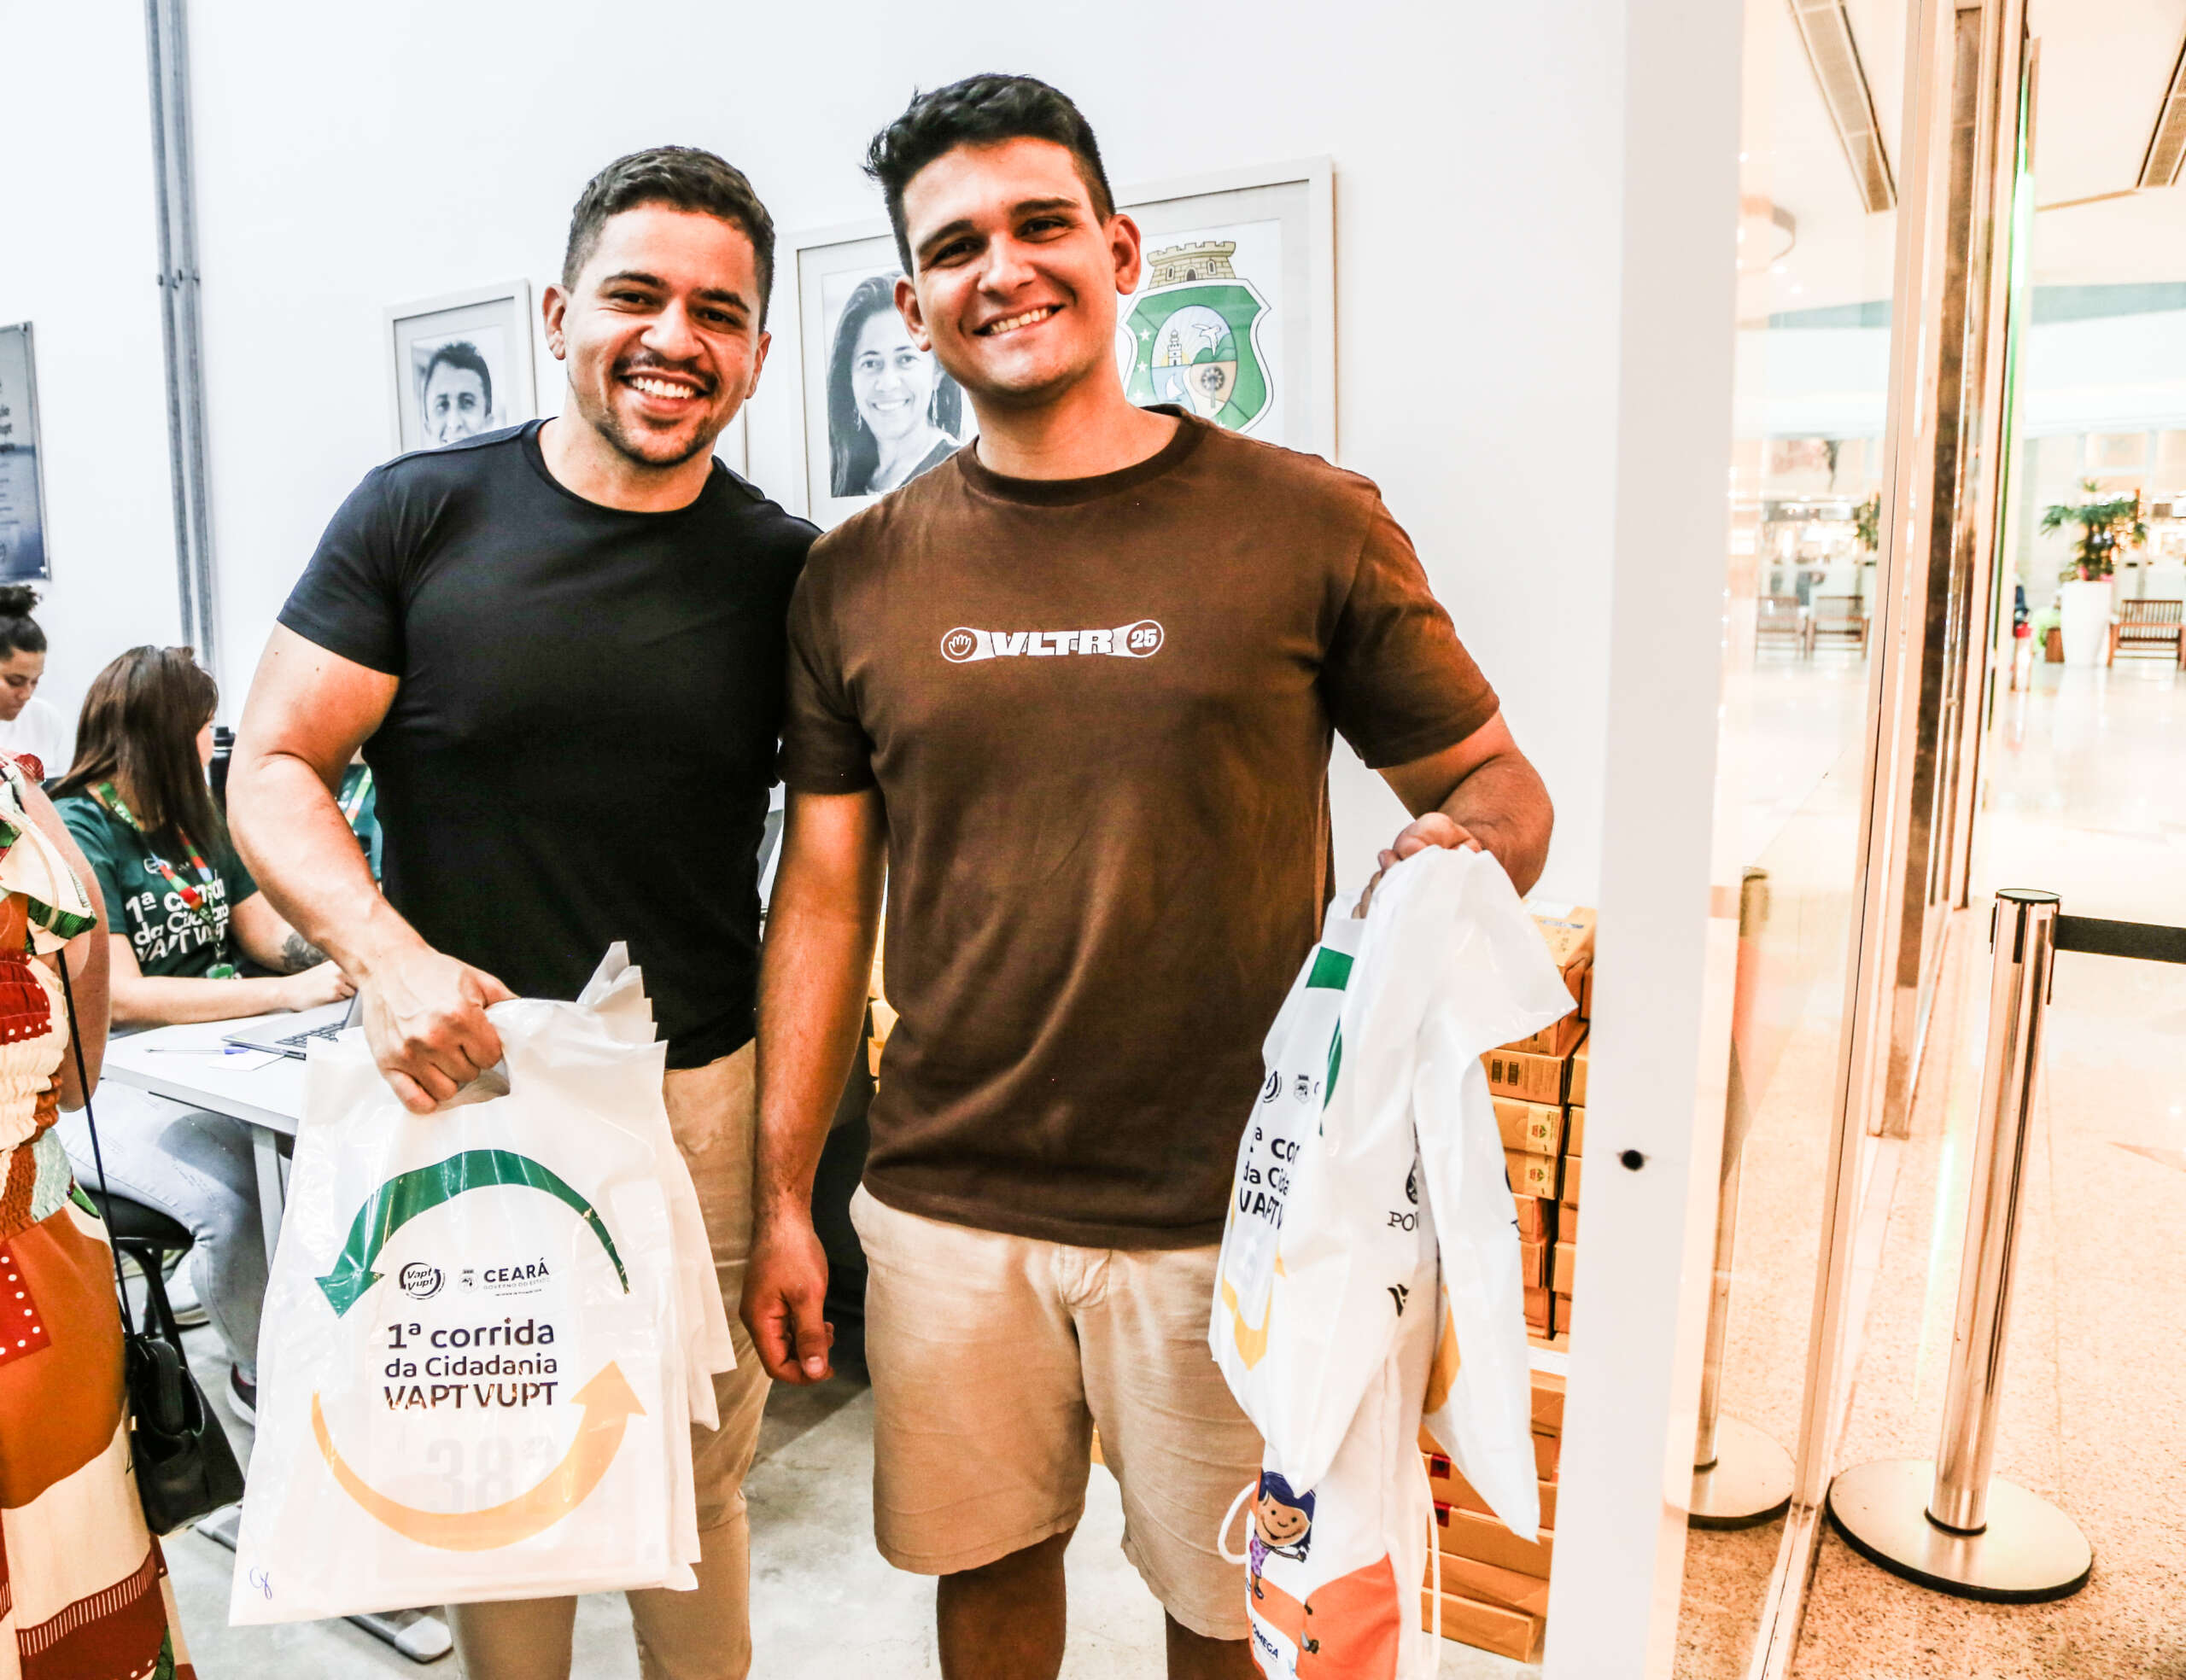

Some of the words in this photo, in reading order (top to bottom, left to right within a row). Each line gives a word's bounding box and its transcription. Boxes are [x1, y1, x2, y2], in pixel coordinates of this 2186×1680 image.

[991, 629, 1113, 656] VLTR
[1131, 628, 1157, 649] 25
[134, 921, 164, 946] da
[407, 1268, 431, 1279] Vapt
[483, 1257, 549, 1283] CEARÁ
[408, 1277, 433, 1291] Vupt
[388, 1322, 422, 1350] 1ª
[430, 1317, 554, 1348] corrida
[384, 1358, 417, 1378] da
[425, 1352, 558, 1377] Cidadania
[384, 1383, 469, 1410] VAPT
[473, 1381, 558, 1408] VUPT
